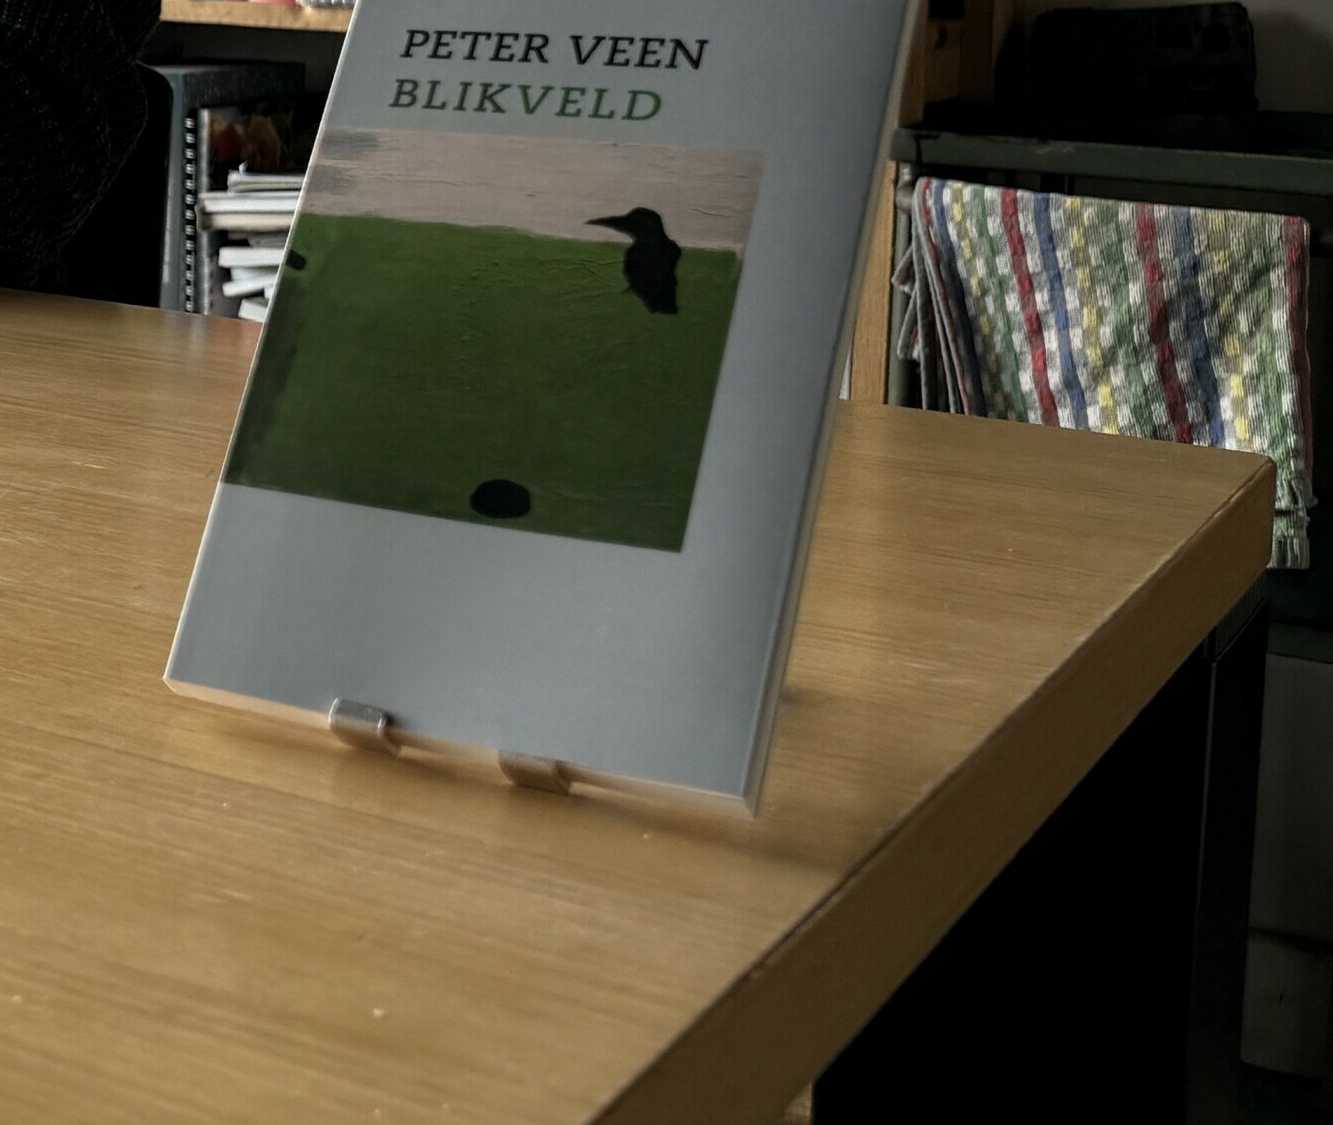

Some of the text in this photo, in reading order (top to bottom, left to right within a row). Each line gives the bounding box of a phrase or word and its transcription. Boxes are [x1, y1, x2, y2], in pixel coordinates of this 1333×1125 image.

[399, 28, 709, 71] PETER VEEN
[388, 78, 662, 121] BLIKVELD
